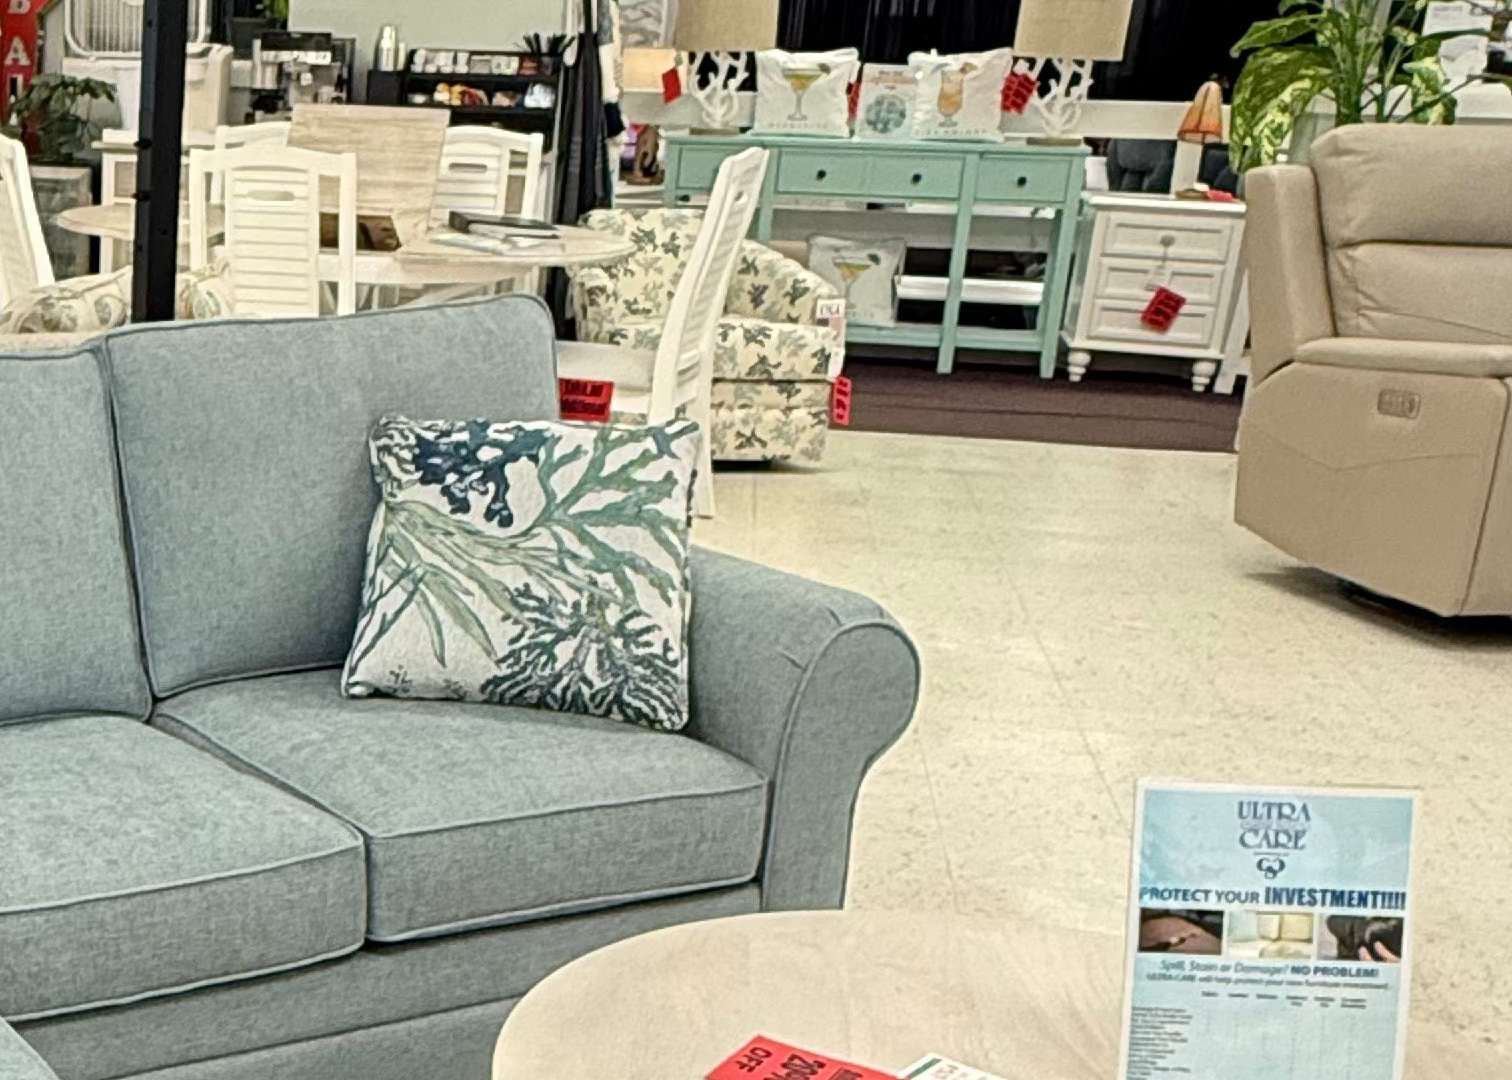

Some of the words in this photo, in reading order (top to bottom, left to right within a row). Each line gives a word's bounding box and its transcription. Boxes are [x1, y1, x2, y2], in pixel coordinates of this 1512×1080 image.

[1237, 800, 1312, 822] ULTRA
[1238, 828, 1308, 851] CARE
[1139, 886, 1212, 904] PROTECT
[1214, 890, 1261, 905] YOUR
[1219, 963, 1232, 972] or
[1291, 964, 1312, 976] NO
[1313, 966, 1380, 978] PROBLEM!
[735, 1046, 773, 1073] OFF
